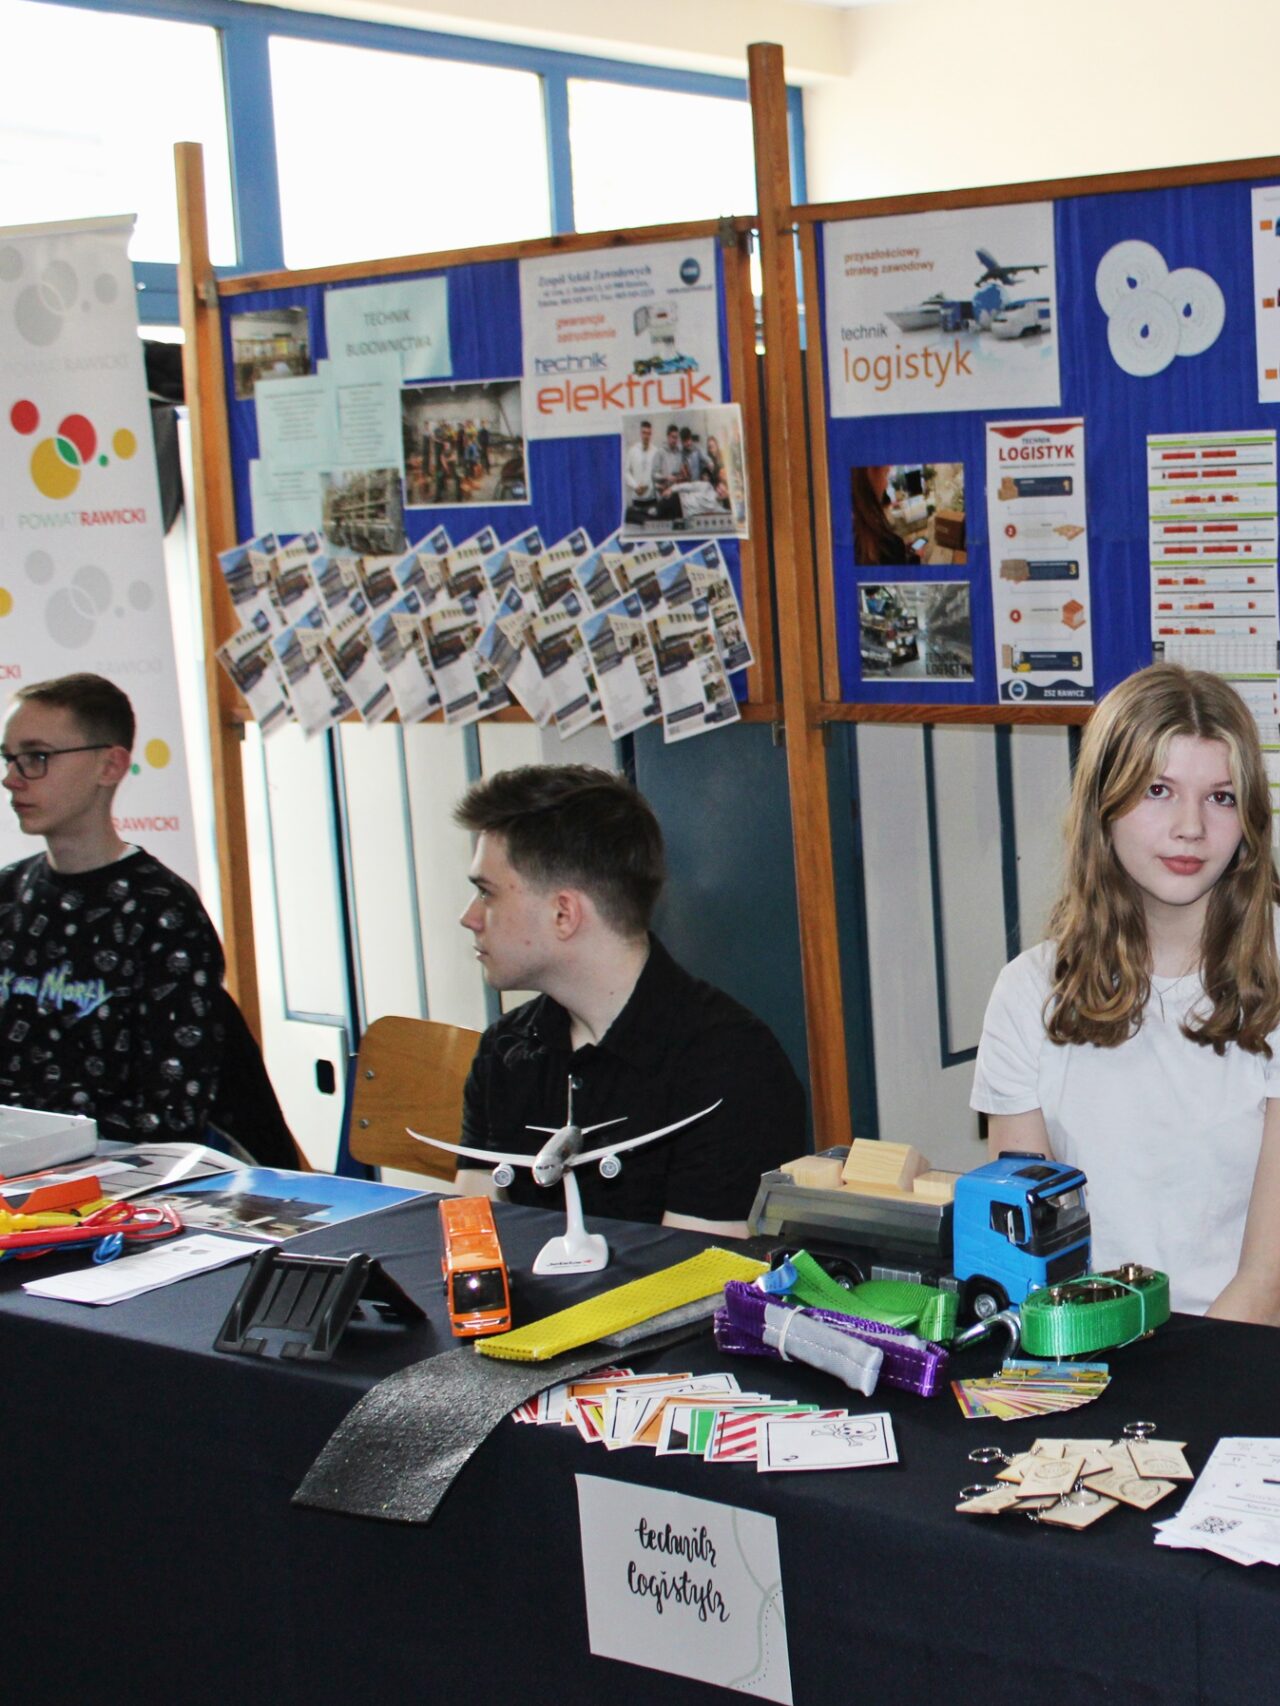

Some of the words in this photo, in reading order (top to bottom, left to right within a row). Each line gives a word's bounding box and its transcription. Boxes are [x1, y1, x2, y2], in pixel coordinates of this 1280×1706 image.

[841, 325, 888, 342] technik
[535, 352, 607, 373] technik
[843, 341, 973, 392] logistyk
[536, 367, 713, 415] elektryk
[999, 445, 1075, 462] LOGISTYK
[1071, 656, 1079, 667] 5
[635, 1517, 716, 1567] technik
[627, 1560, 730, 1623] logistyk
